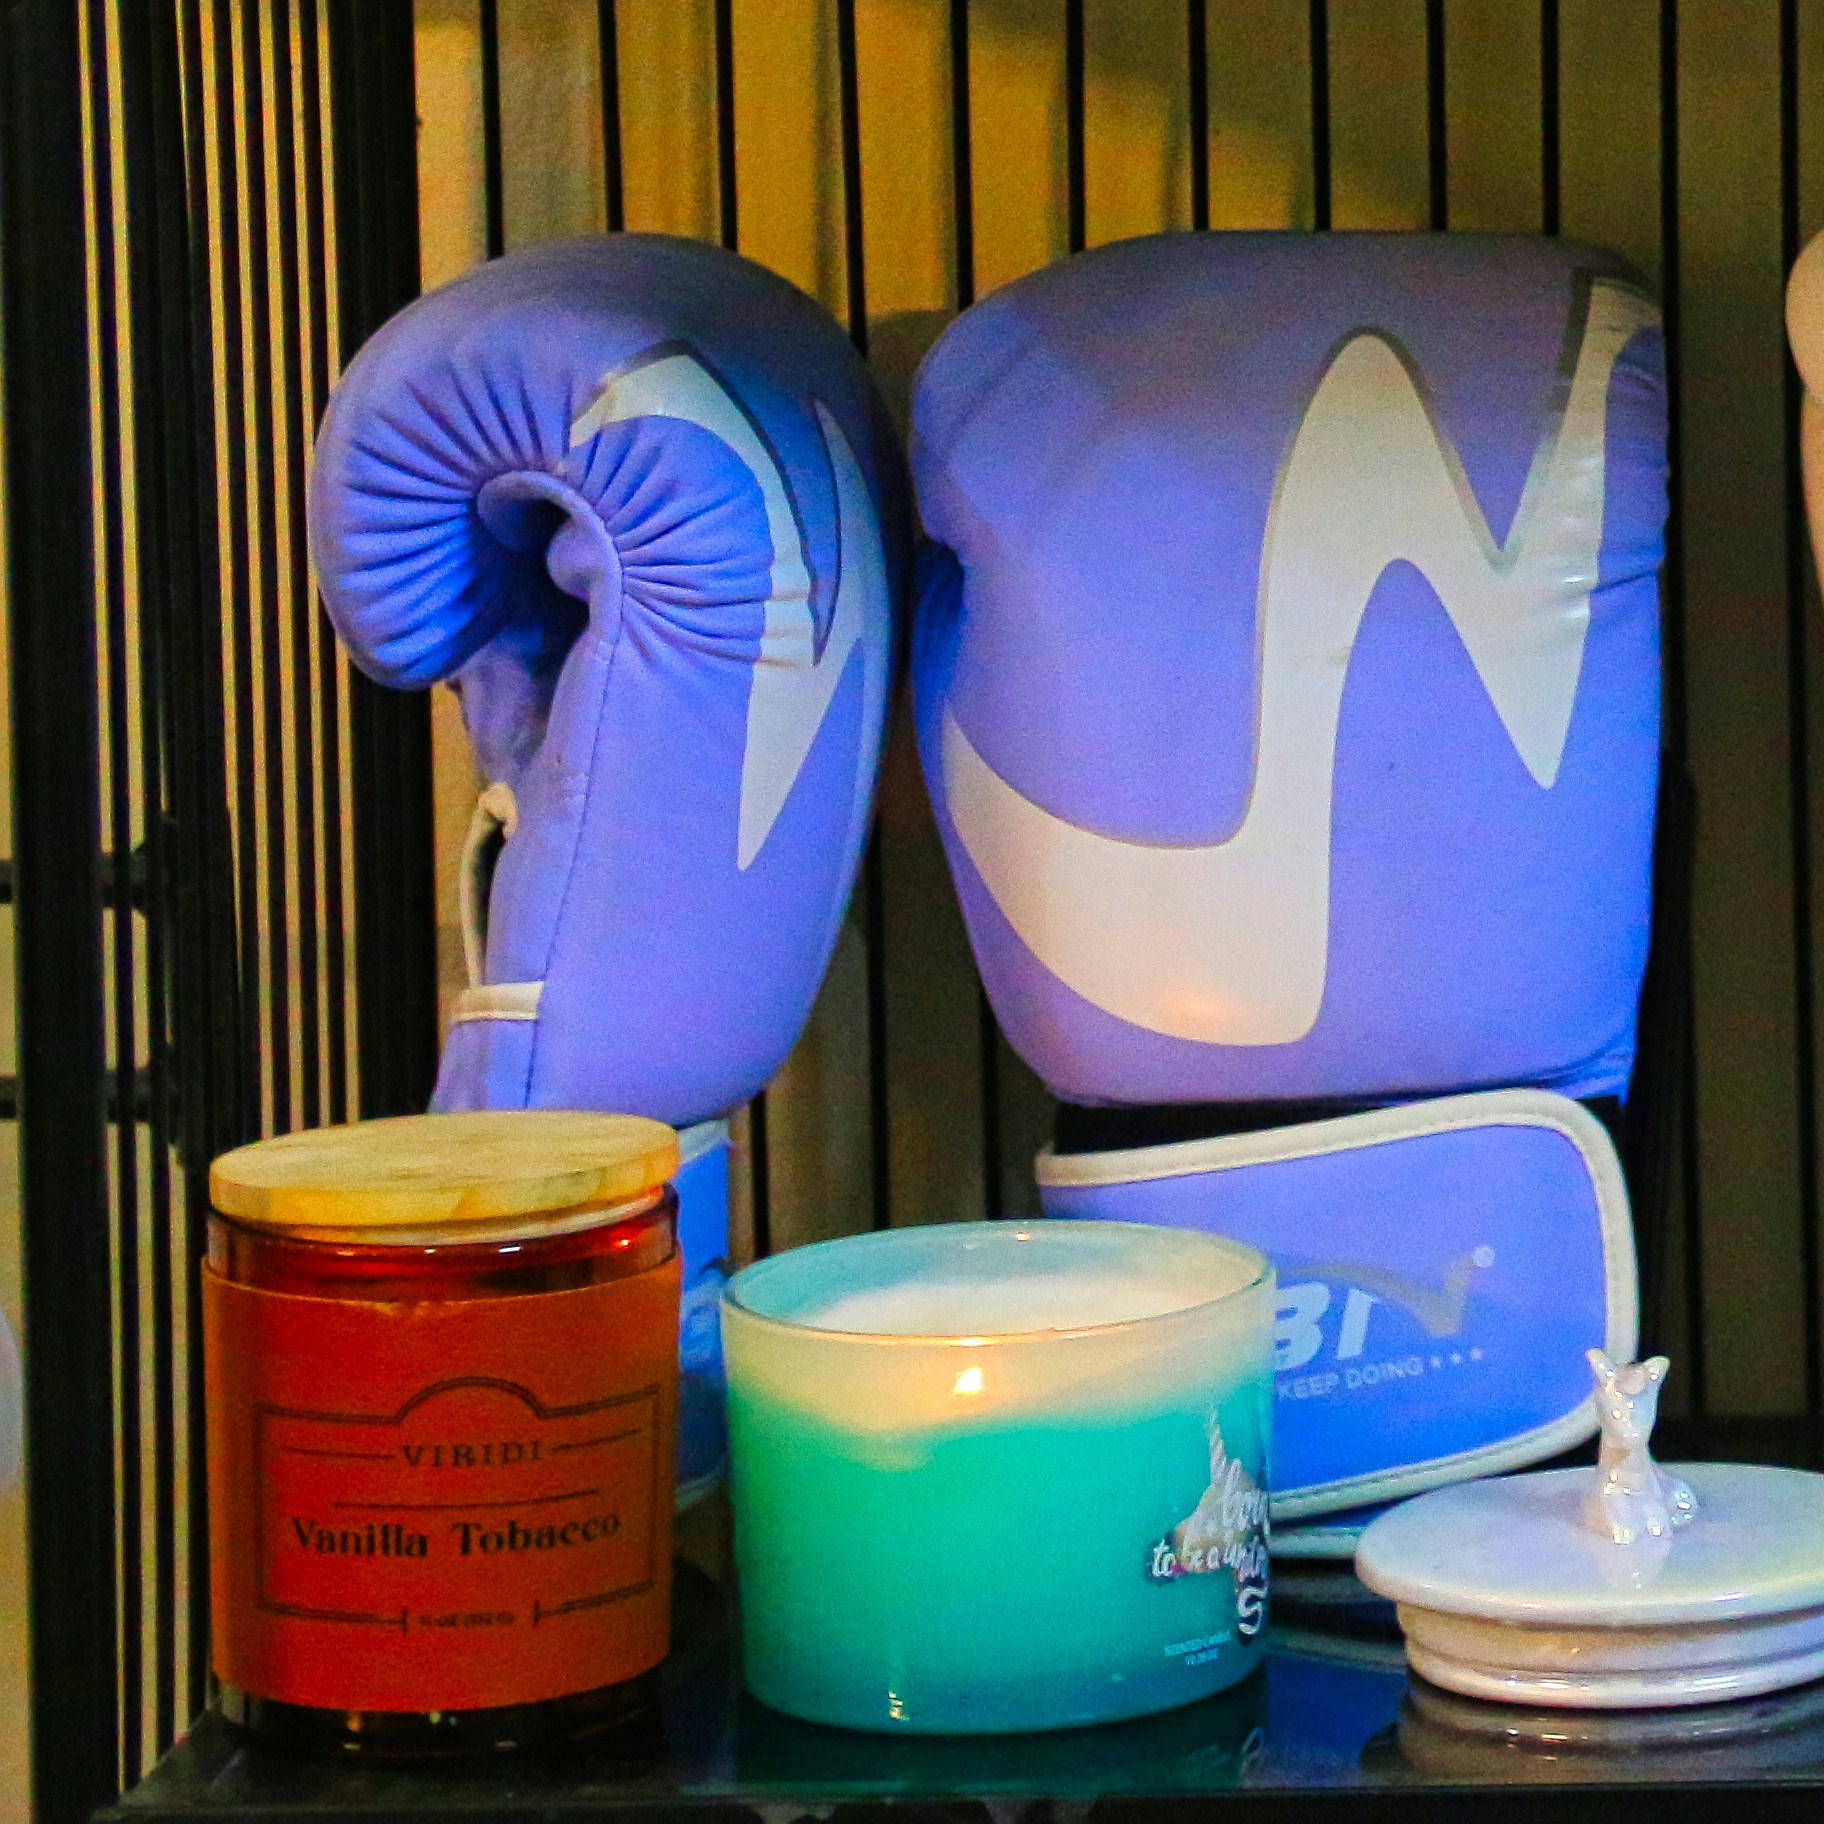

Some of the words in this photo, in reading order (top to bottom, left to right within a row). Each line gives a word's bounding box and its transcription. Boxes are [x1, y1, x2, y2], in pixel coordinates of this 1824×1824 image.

[1277, 1372, 1339, 1401] KEEP
[402, 1440, 542, 1468] VIRIDI
[292, 1515, 430, 1558] Vanilla
[449, 1509, 622, 1558] Tobacco
